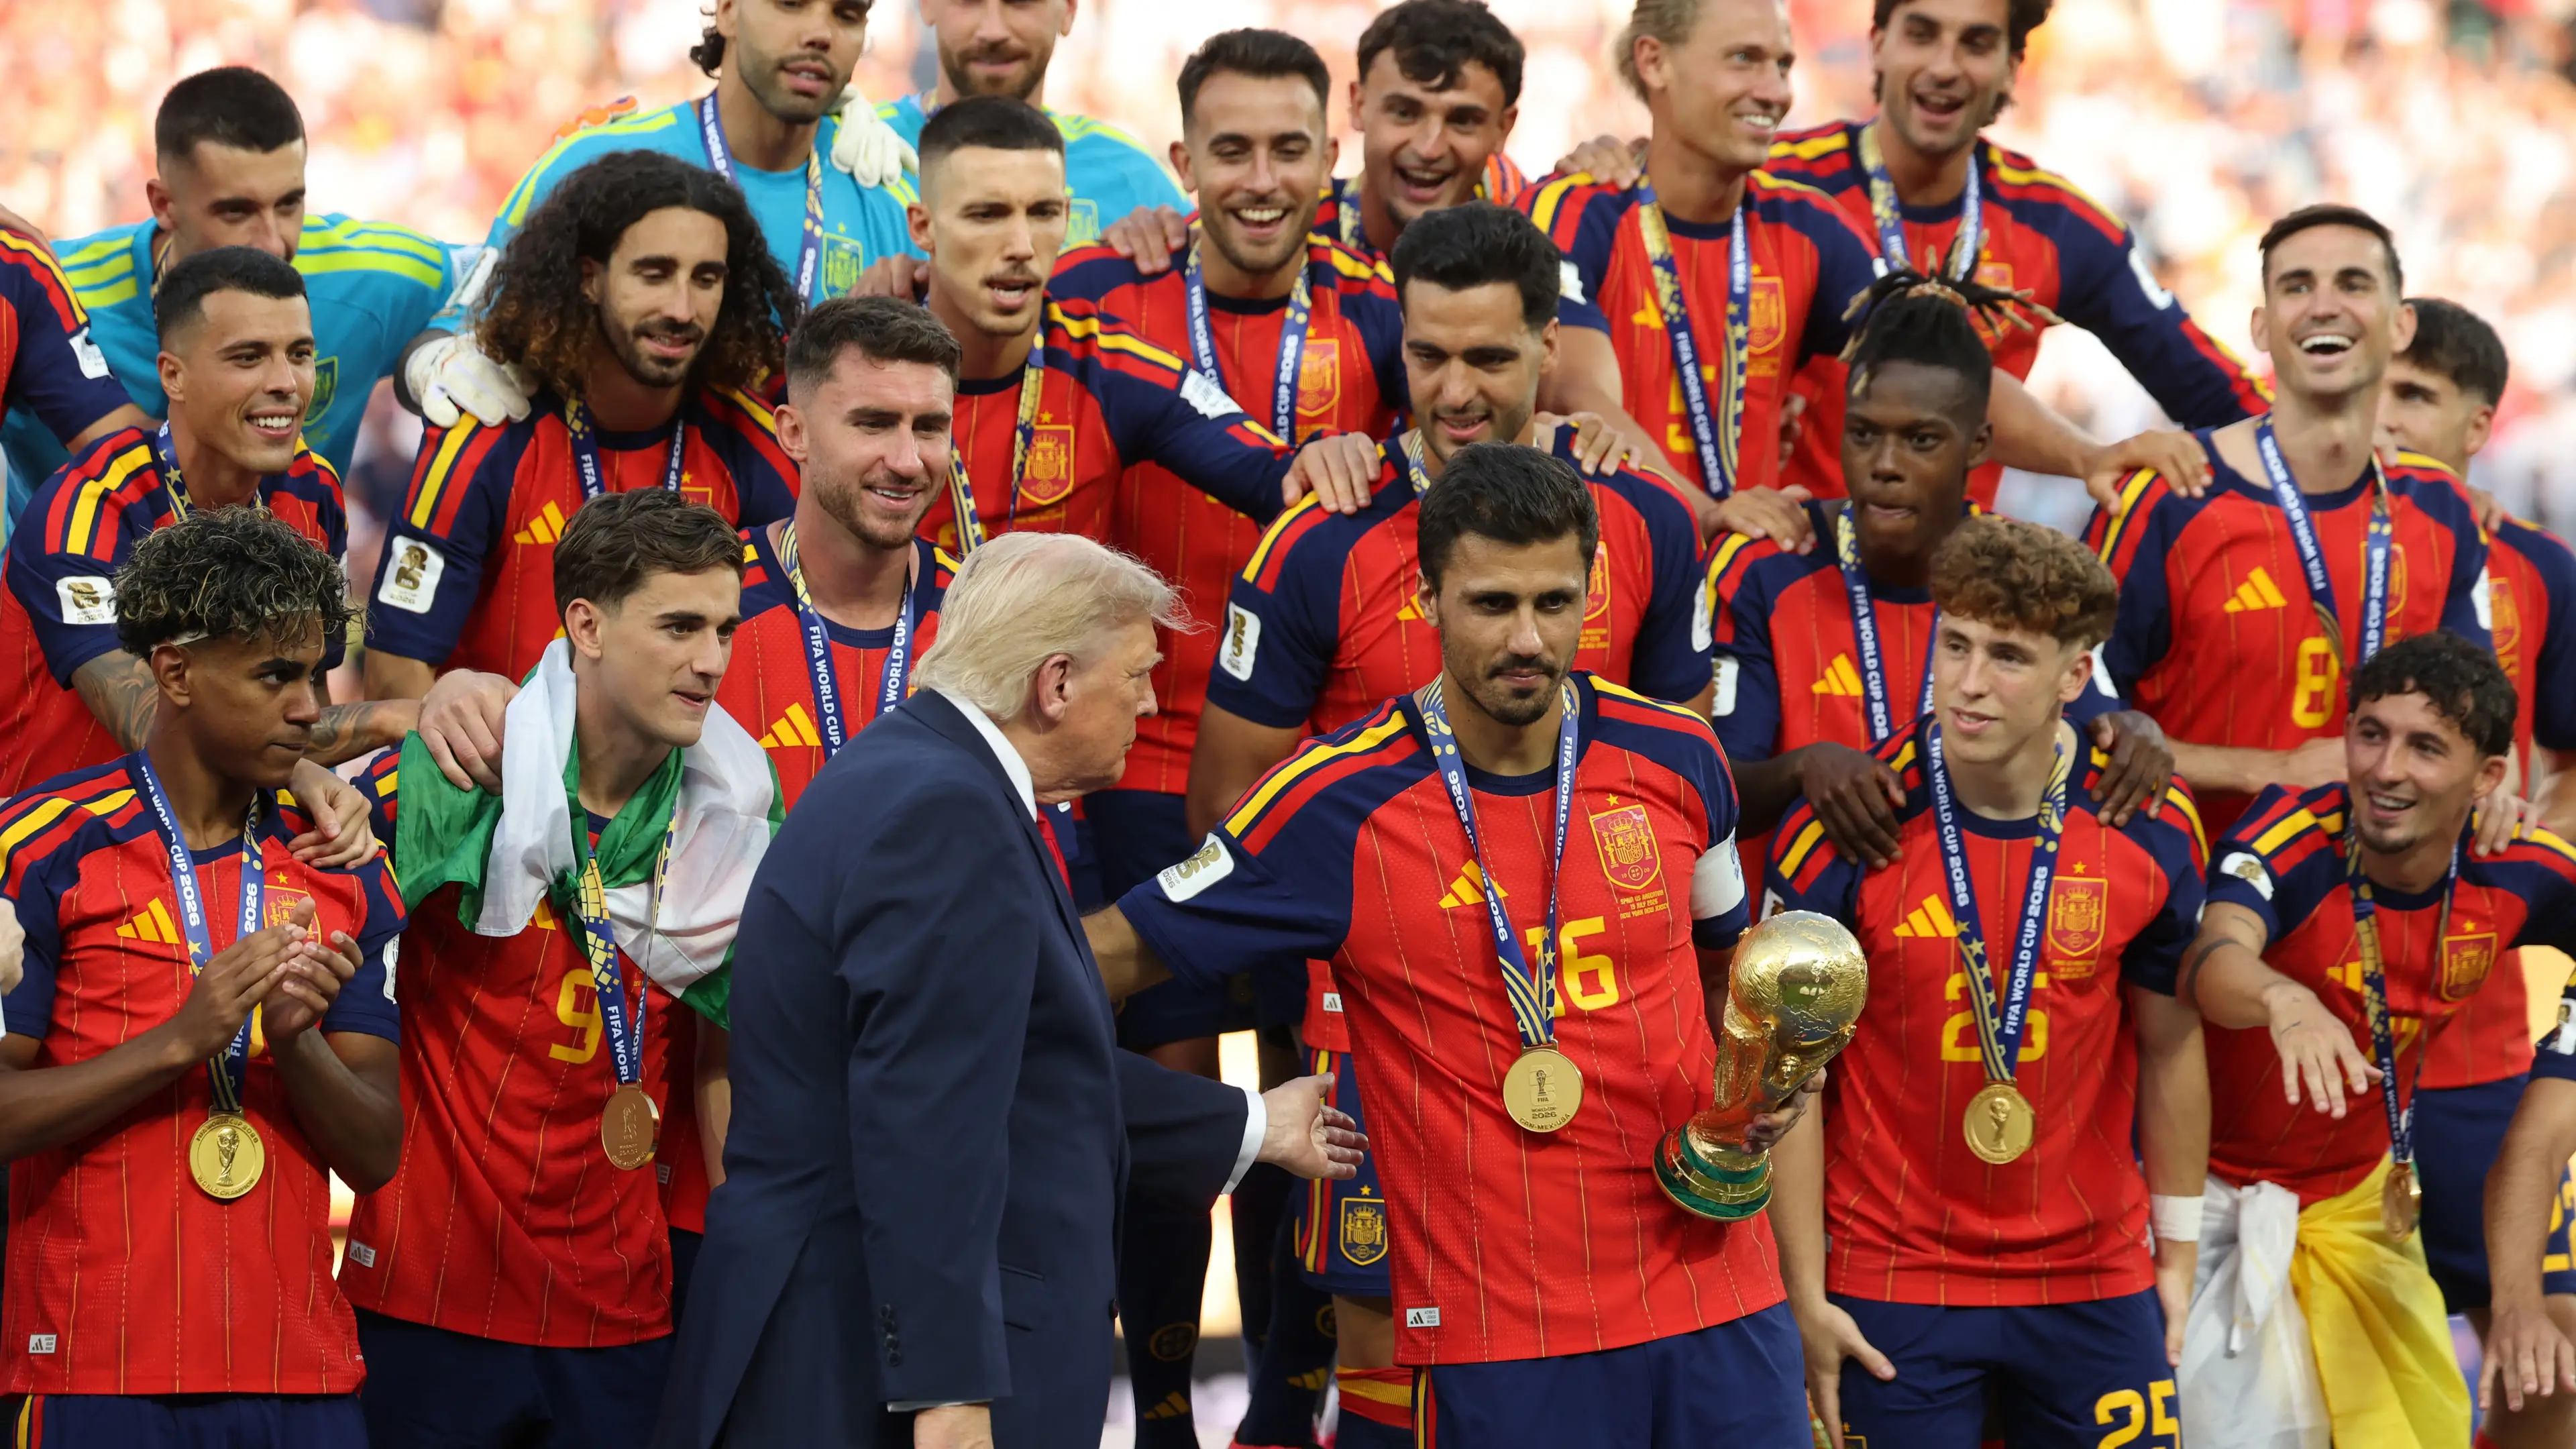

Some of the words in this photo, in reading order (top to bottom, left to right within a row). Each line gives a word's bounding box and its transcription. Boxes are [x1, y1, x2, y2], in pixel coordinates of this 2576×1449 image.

[1191, 284, 1204, 319] FIFA
[1193, 317, 1214, 369] WORLD
[1675, 331, 1693, 366] FIFA
[1277, 384, 1291, 415] CUP
[1682, 362, 1705, 415] WORLD
[1694, 413, 1712, 444] CUP
[581, 453, 596, 486] FIFA
[2279, 482, 2300, 510] CUP
[2290, 507, 2317, 560] WORLD
[1852, 584, 1870, 617] FIFA
[2367, 598, 2382, 628] CUP
[809, 625, 824, 658] FIFA
[894, 617, 906, 647] CUP
[1859, 616, 1878, 671] WORLD
[815, 659, 835, 714] WORLD
[885, 648, 904, 704] WORLD
[1867, 671, 1883, 701] CUP
[2292, 637, 2339, 729] 8
[826, 715, 841, 748] CUP
[1871, 701, 1889, 741] 202
[1564, 736, 1573, 767] FIFA
[1931, 737, 1943, 770] FIFA
[1448, 770, 1468, 822] 2026
[1560, 769, 1571, 824] WORLD
[1935, 770, 1953, 824] WORLD
[1556, 826, 1565, 857] CUP
[1943, 825, 1960, 854] CUP
[170, 845, 188, 873] CUP
[179, 873, 201, 928] 2026
[1162, 870, 1175, 889] 026
[1949, 855, 1970, 908] 2026
[2028, 866, 2049, 917] 2026
[244, 883, 258, 933] 2026
[1620, 896, 1634, 905] SPAIN
[1642, 890, 1664, 900] ARGENTINA
[1631, 909, 1644, 917] YORK
[1655, 902, 1669, 912] JERSEY
[1636, 901, 1646, 909] JULY
[1486, 889, 1509, 943] 2026
[2021, 918, 2038, 949] CUP
[1525, 916, 1619, 1017] 16
[2010, 949, 2032, 1002] WORLD
[548, 968, 604, 1064] 9
[607, 1006, 623, 1038] FIFA
[2004, 1004, 2022, 1035] FIFA
[614, 1039, 630, 1084] WORL
[2381, 1057, 2394, 1087] FIFA
[229, 1118, 242, 1126] CUP
[197, 1175, 219, 1194] WORLD
[219, 1177, 255, 1196] CHAMPION
[2094, 1379, 2180, 1449] 25
